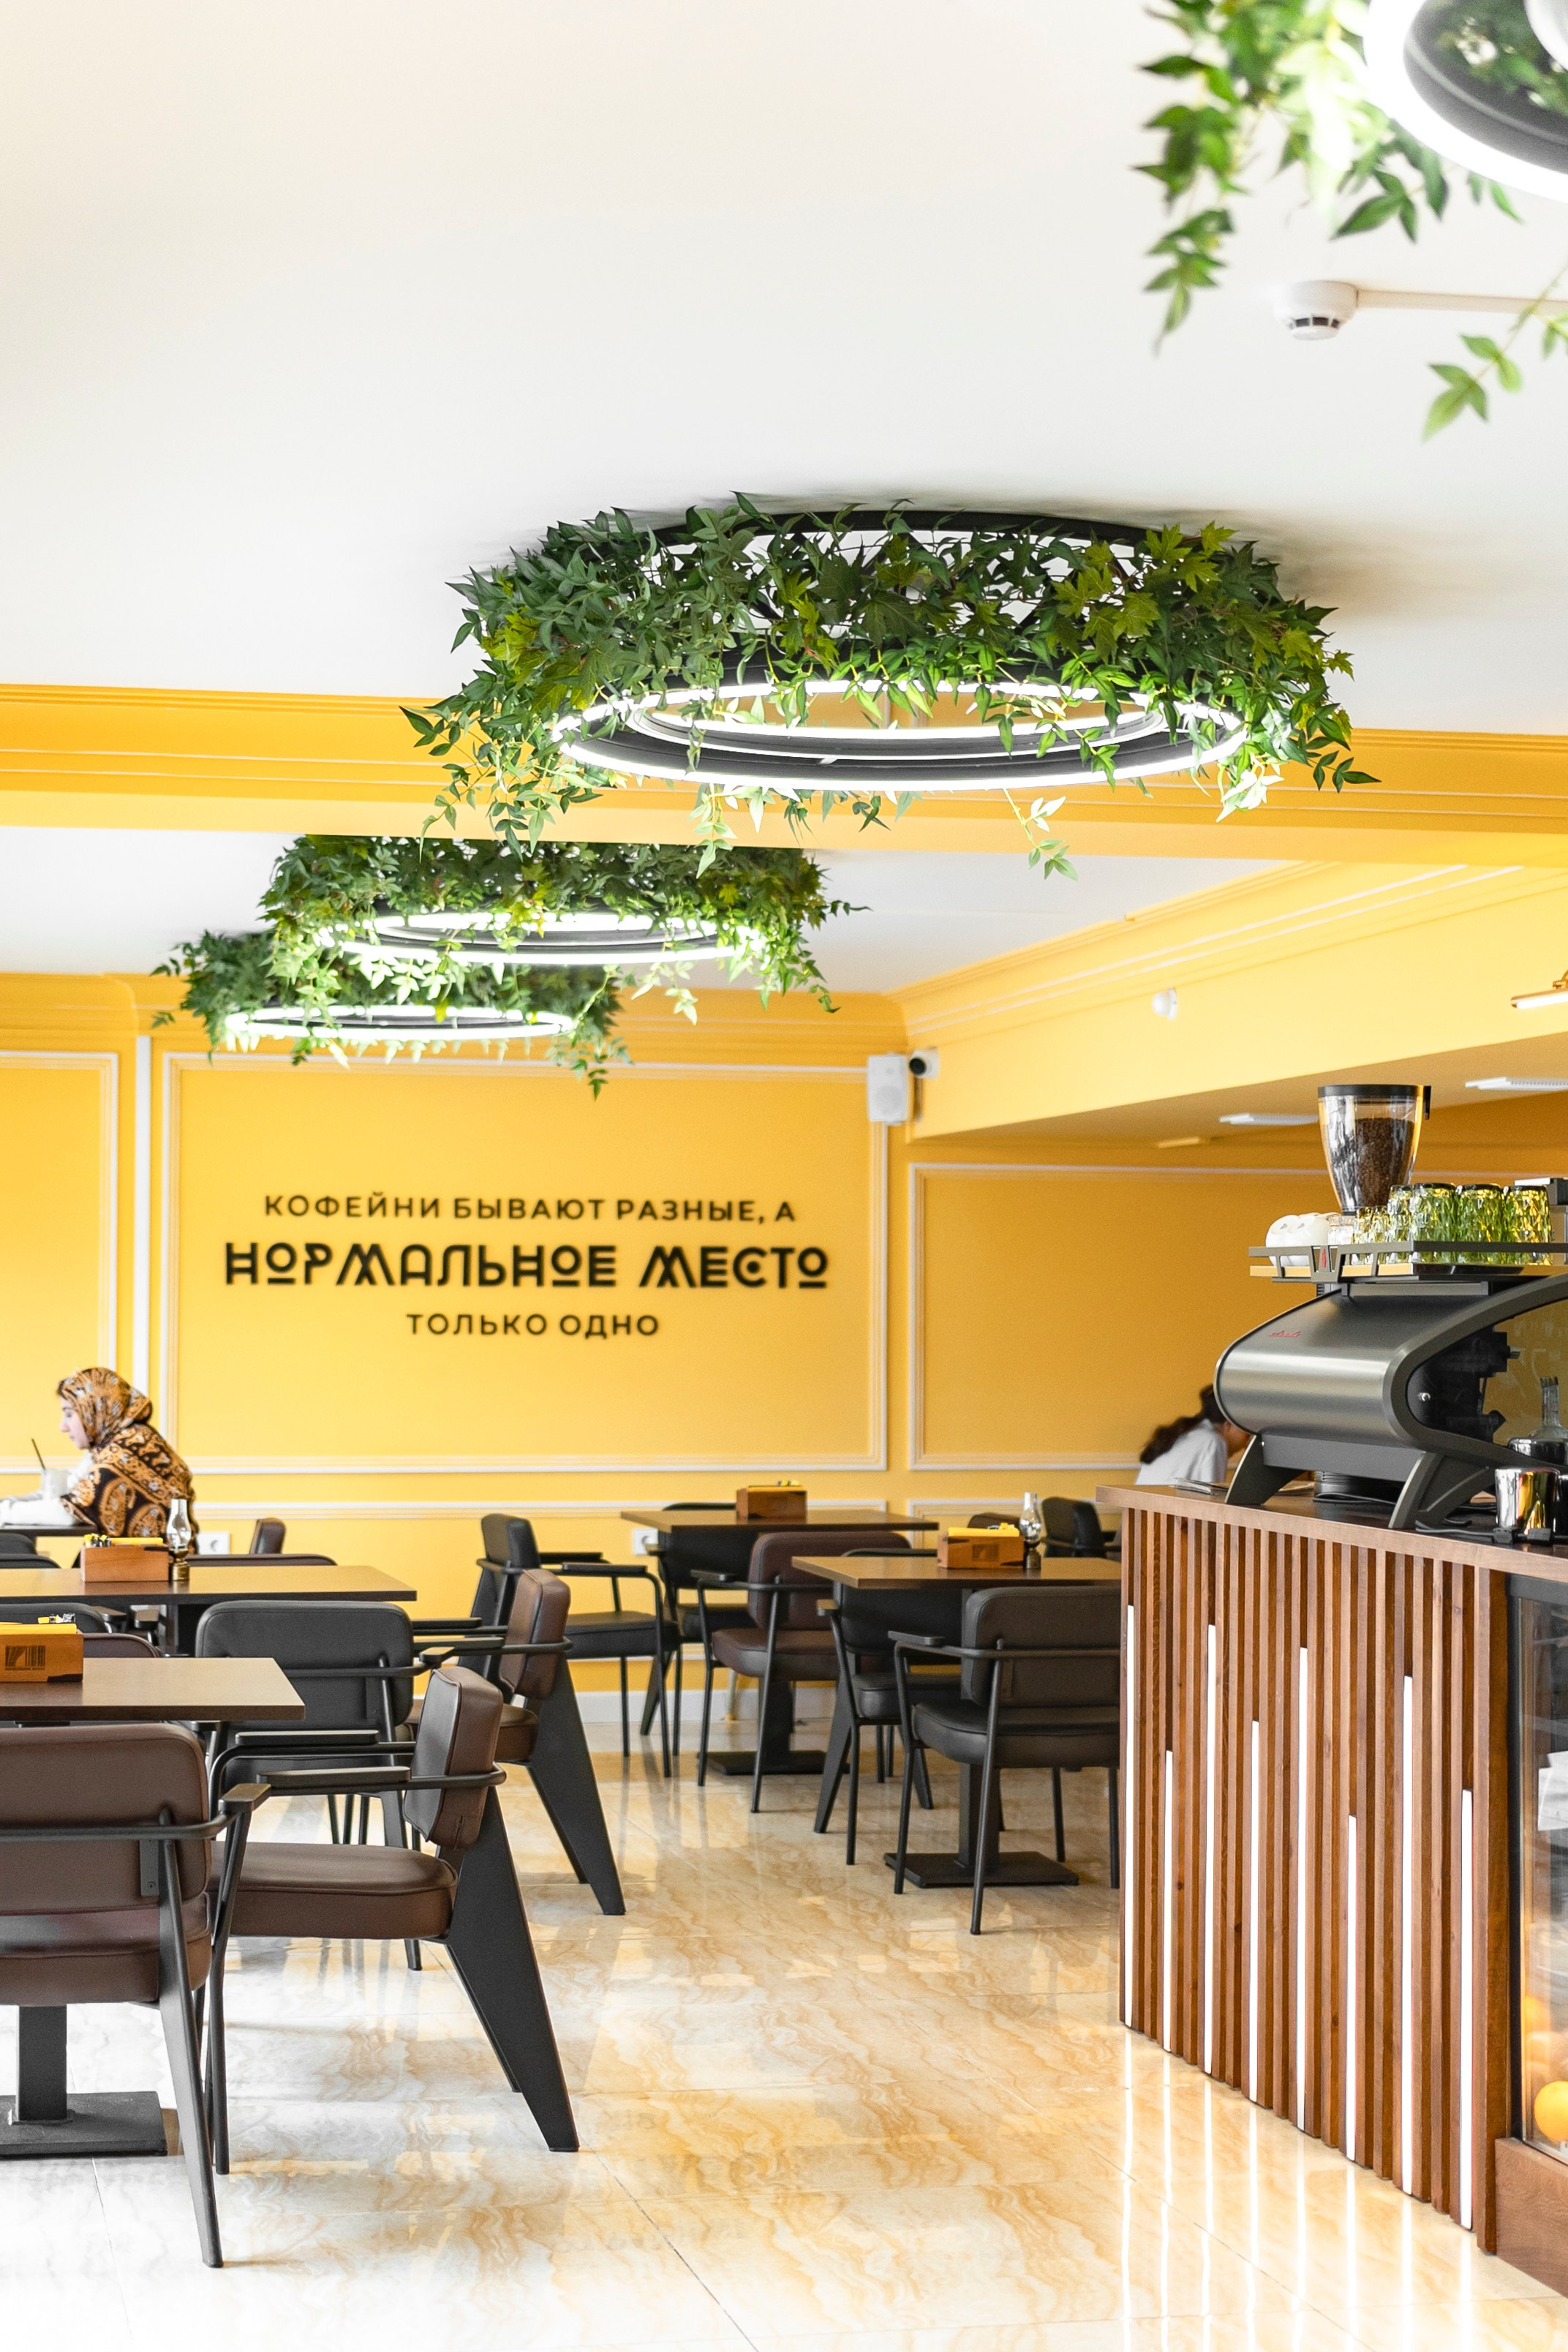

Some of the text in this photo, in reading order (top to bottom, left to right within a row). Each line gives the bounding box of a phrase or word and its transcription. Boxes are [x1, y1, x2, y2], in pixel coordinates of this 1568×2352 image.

[265, 1191, 796, 1225] КОФЕЙНИ БЫВАЮТ РАЗНЫЕ, А
[225, 1242, 829, 1290] НОРМАЛЬНОЕ МЕСТО
[406, 1313, 659, 1340] ТОЛЬКО ОДНО
